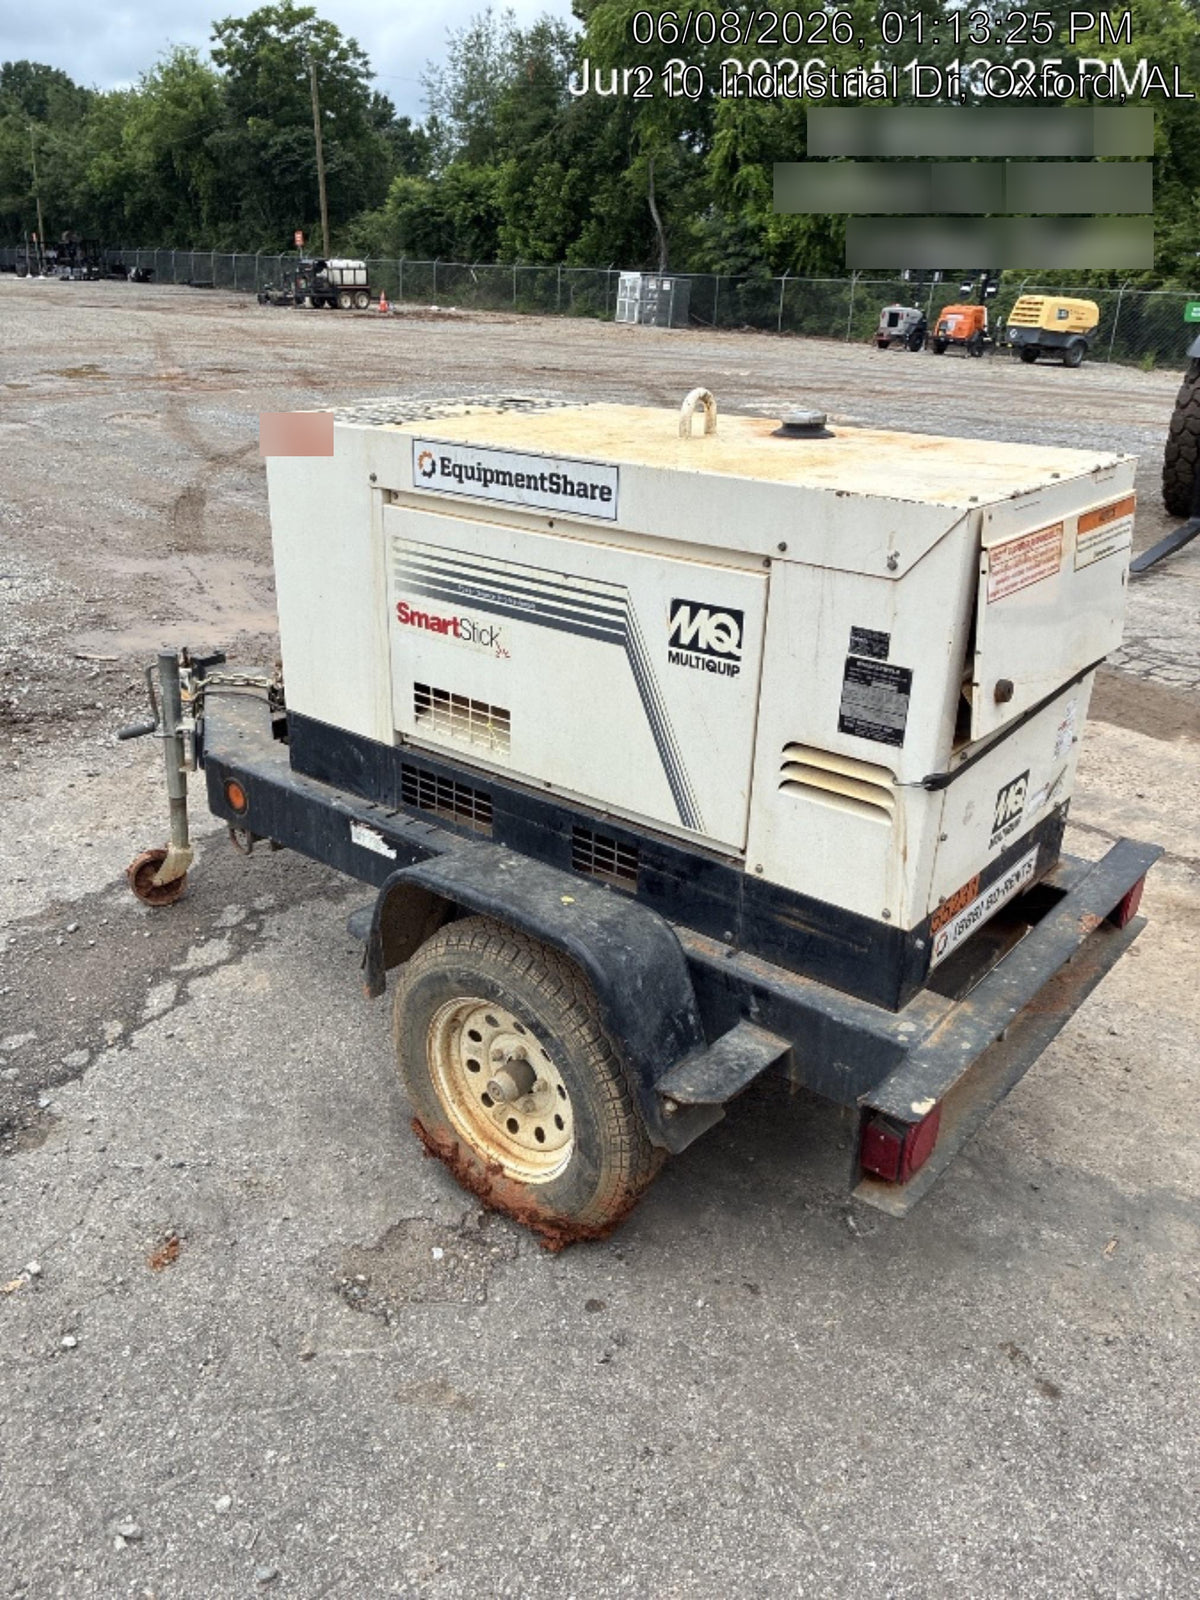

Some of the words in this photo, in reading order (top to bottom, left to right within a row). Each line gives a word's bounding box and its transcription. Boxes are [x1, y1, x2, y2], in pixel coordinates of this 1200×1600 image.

[440, 456, 613, 502] EquipmentShare
[669, 603, 742, 656] MQ
[668, 650, 741, 678] MULTIQUIP
